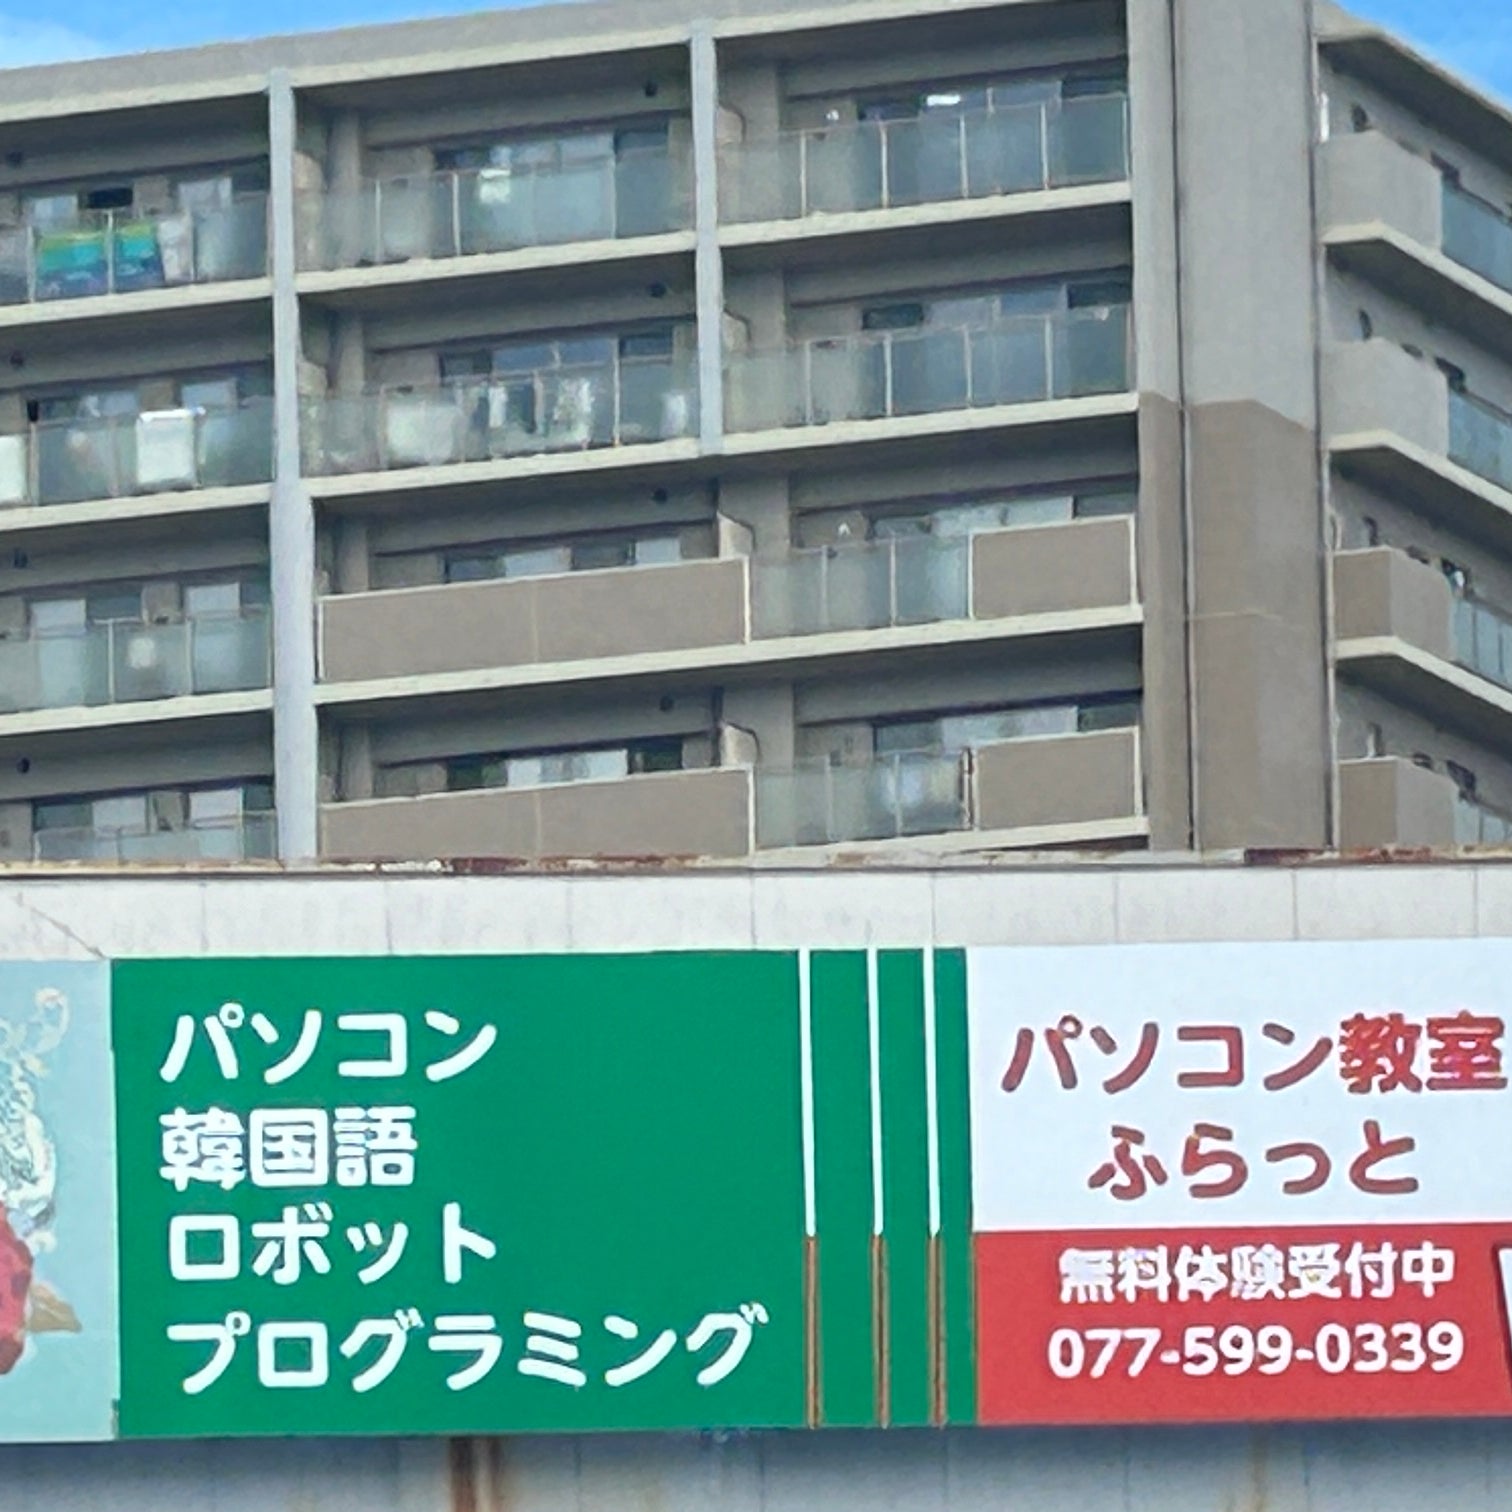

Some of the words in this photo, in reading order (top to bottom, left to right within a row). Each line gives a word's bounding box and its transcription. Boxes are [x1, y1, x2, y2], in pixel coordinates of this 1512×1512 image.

[160, 1002, 497, 1083] パソコン
[1001, 1010, 1508, 1094] パソコン教室
[159, 1105, 418, 1190] 韓国語
[1087, 1119, 1419, 1200] ふらっと
[169, 1202, 497, 1285] ロボット
[1058, 1240, 1455, 1304] 無料体験受付中
[167, 1302, 770, 1394] プログラミング
[1047, 1320, 1464, 1379] 077-599-0339
